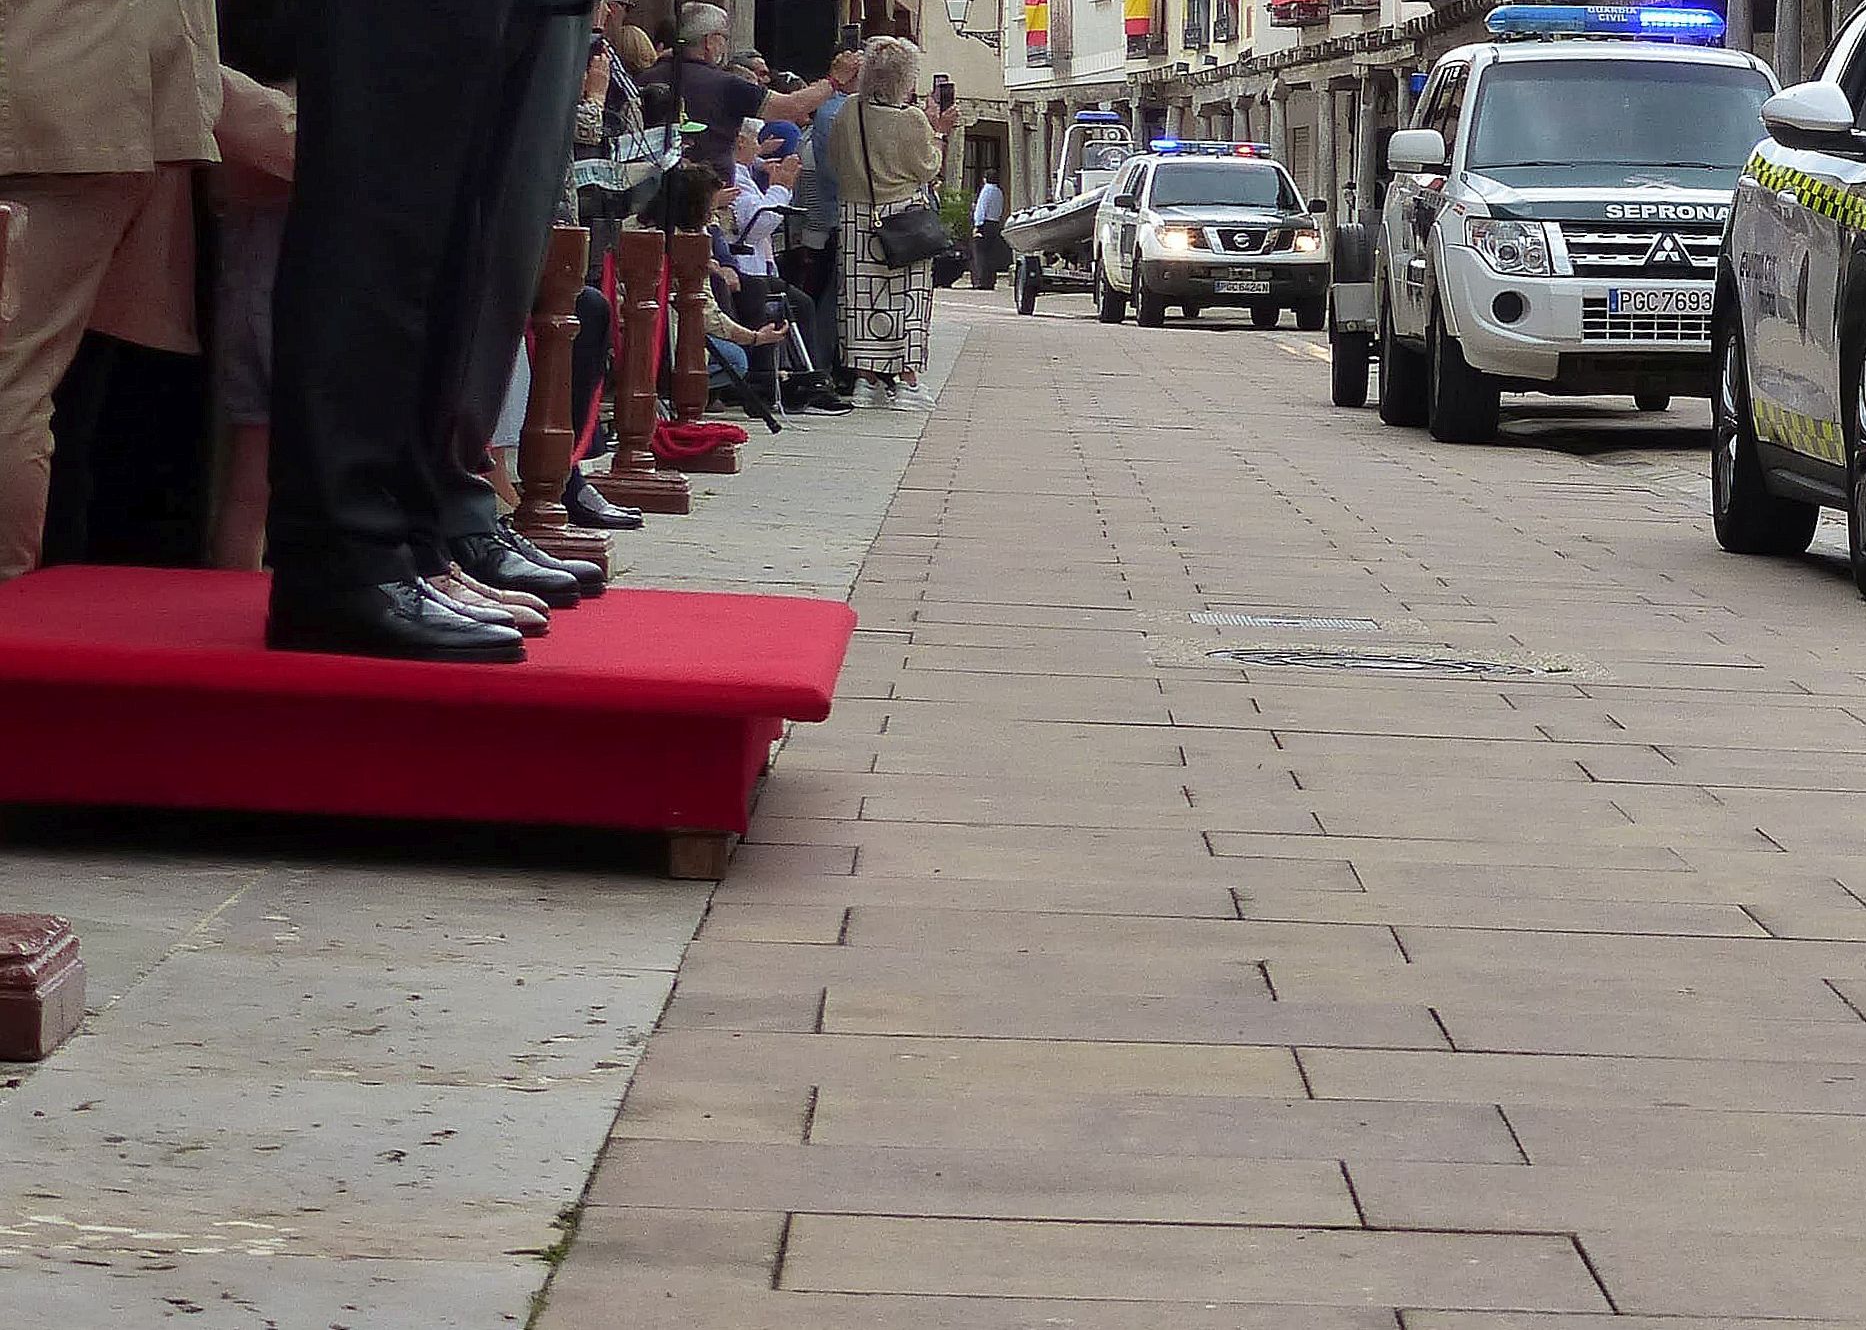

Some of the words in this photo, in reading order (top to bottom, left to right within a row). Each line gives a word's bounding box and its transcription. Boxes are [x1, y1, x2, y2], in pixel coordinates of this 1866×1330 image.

[1598, 13, 1628, 22] CIVIL
[1605, 203, 1731, 220] SEPRONA
[1619, 291, 1713, 312] PGC7693
